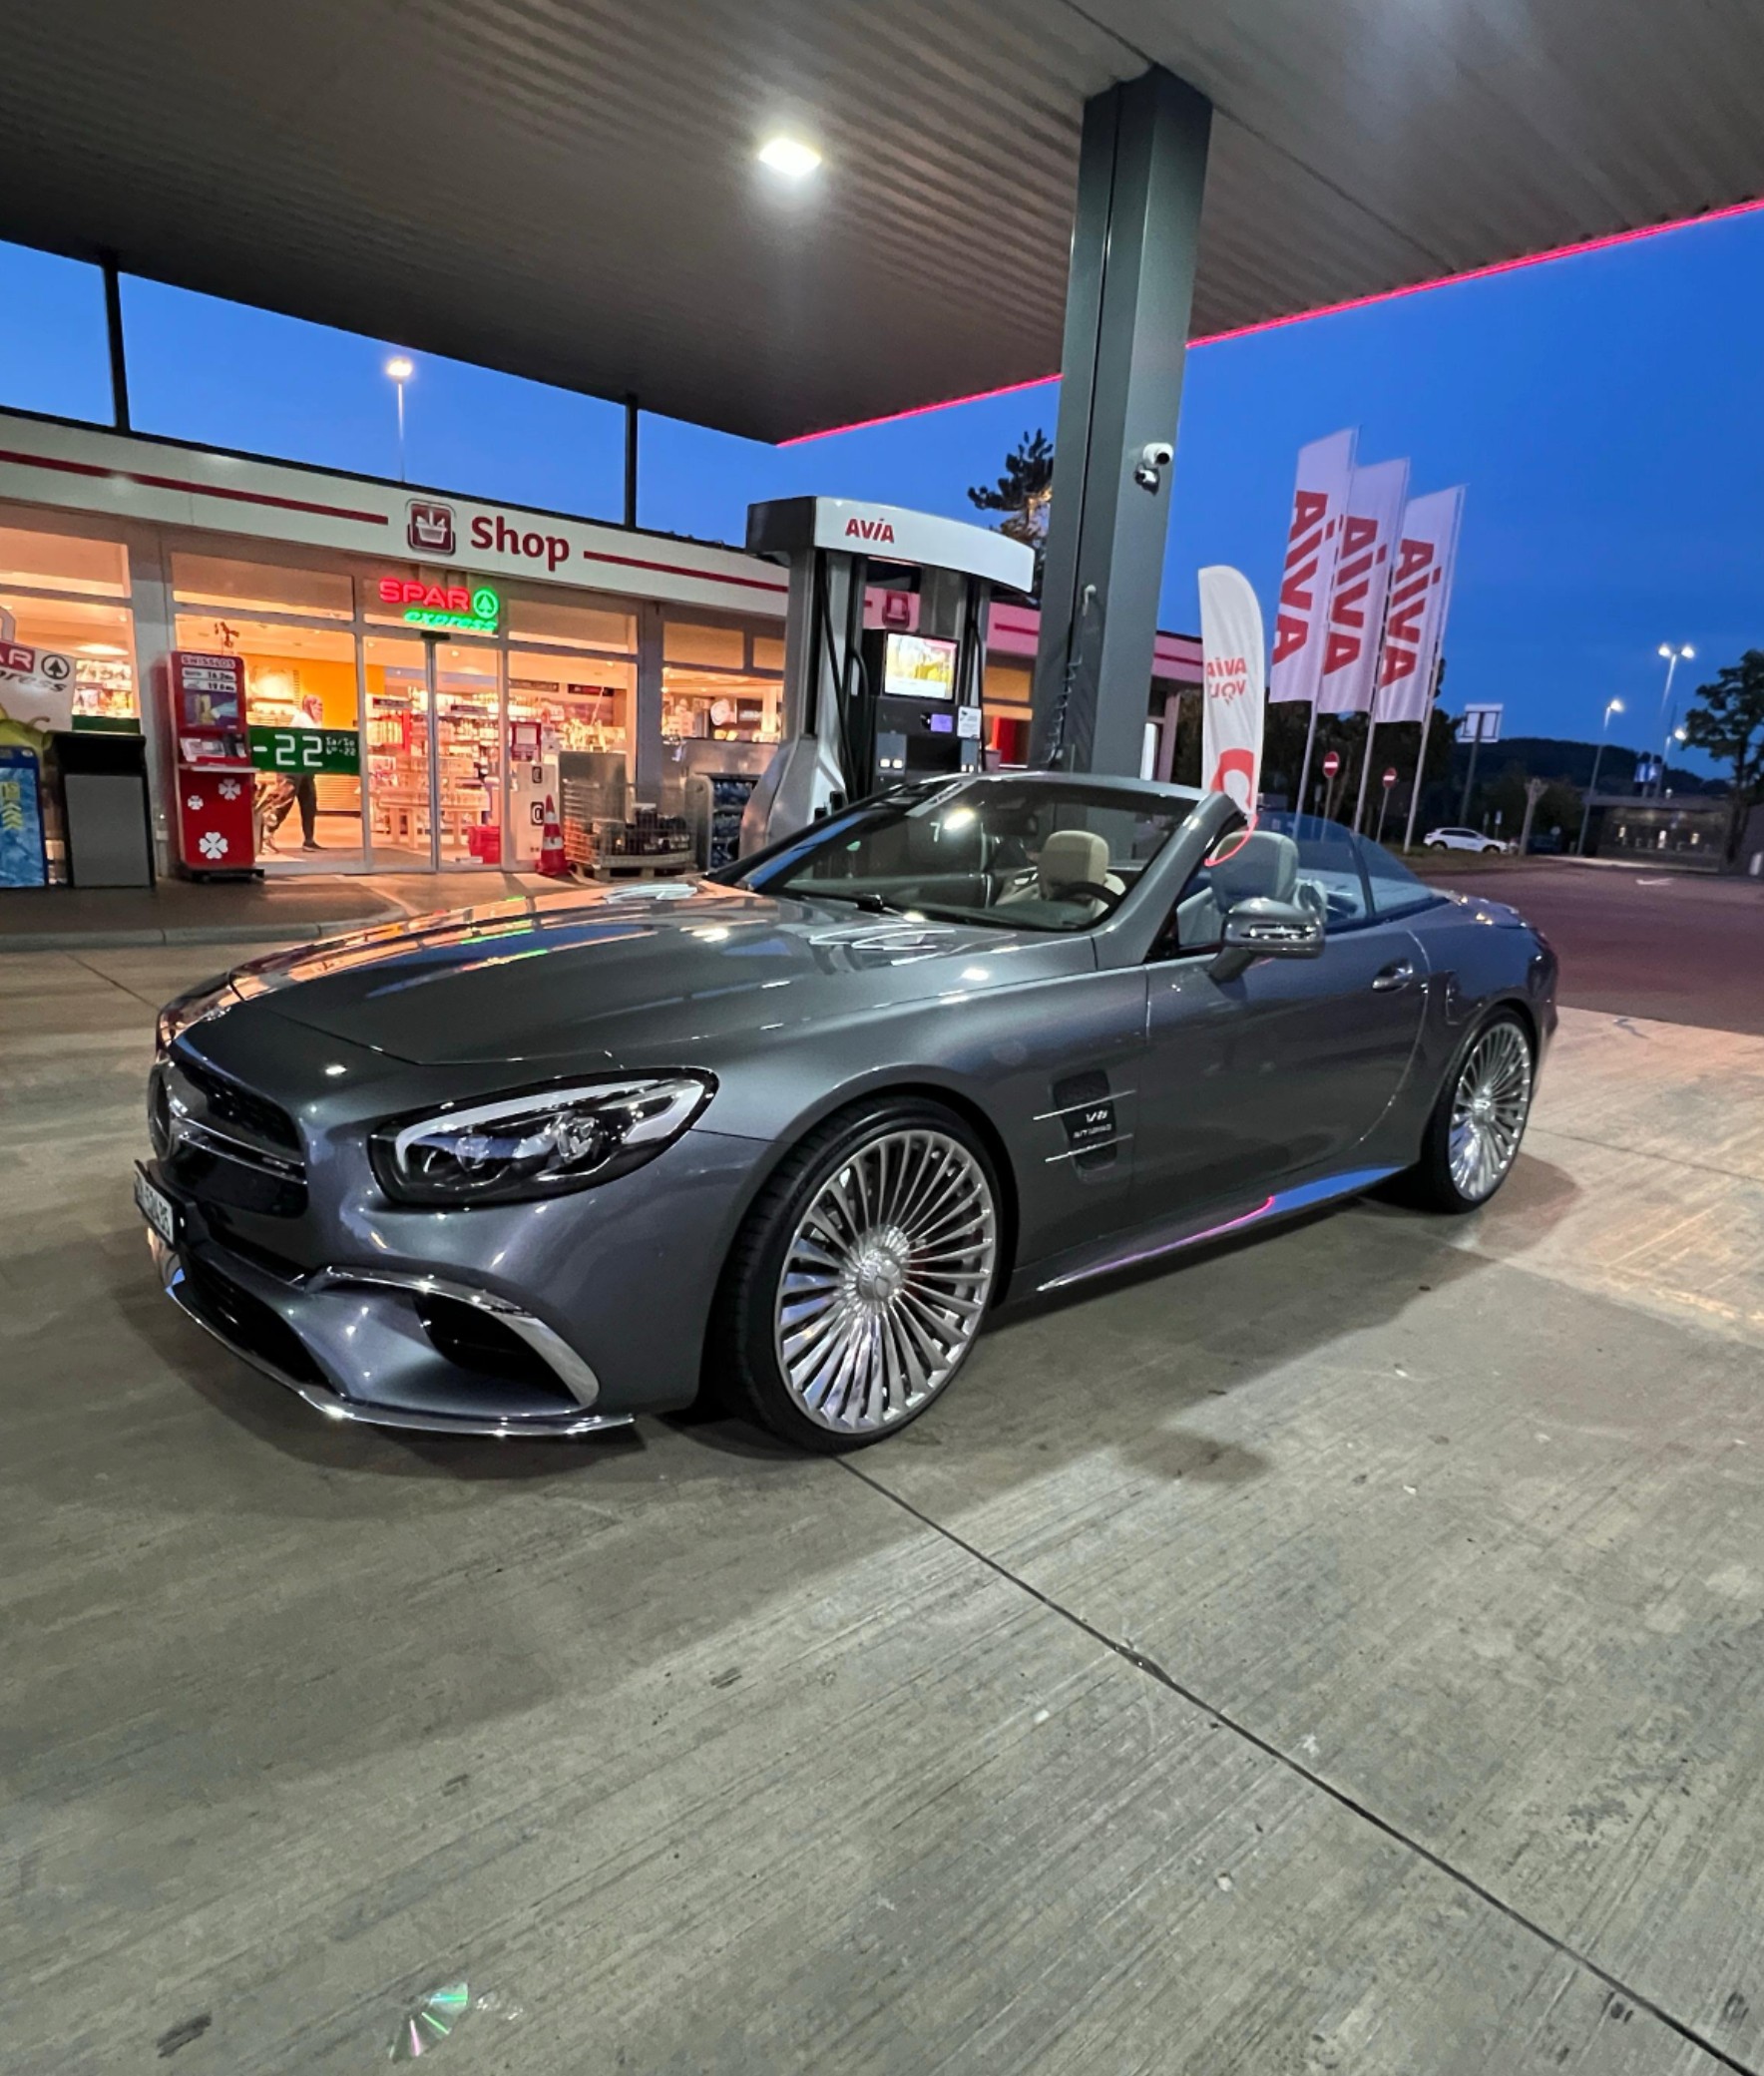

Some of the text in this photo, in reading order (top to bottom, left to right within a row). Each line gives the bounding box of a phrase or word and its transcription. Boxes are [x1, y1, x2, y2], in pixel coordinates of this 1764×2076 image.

[470, 515, 570, 572] Shop
[845, 517, 895, 544] AVIA
[379, 578, 470, 612] SPAR
[403, 610, 498, 631] express
